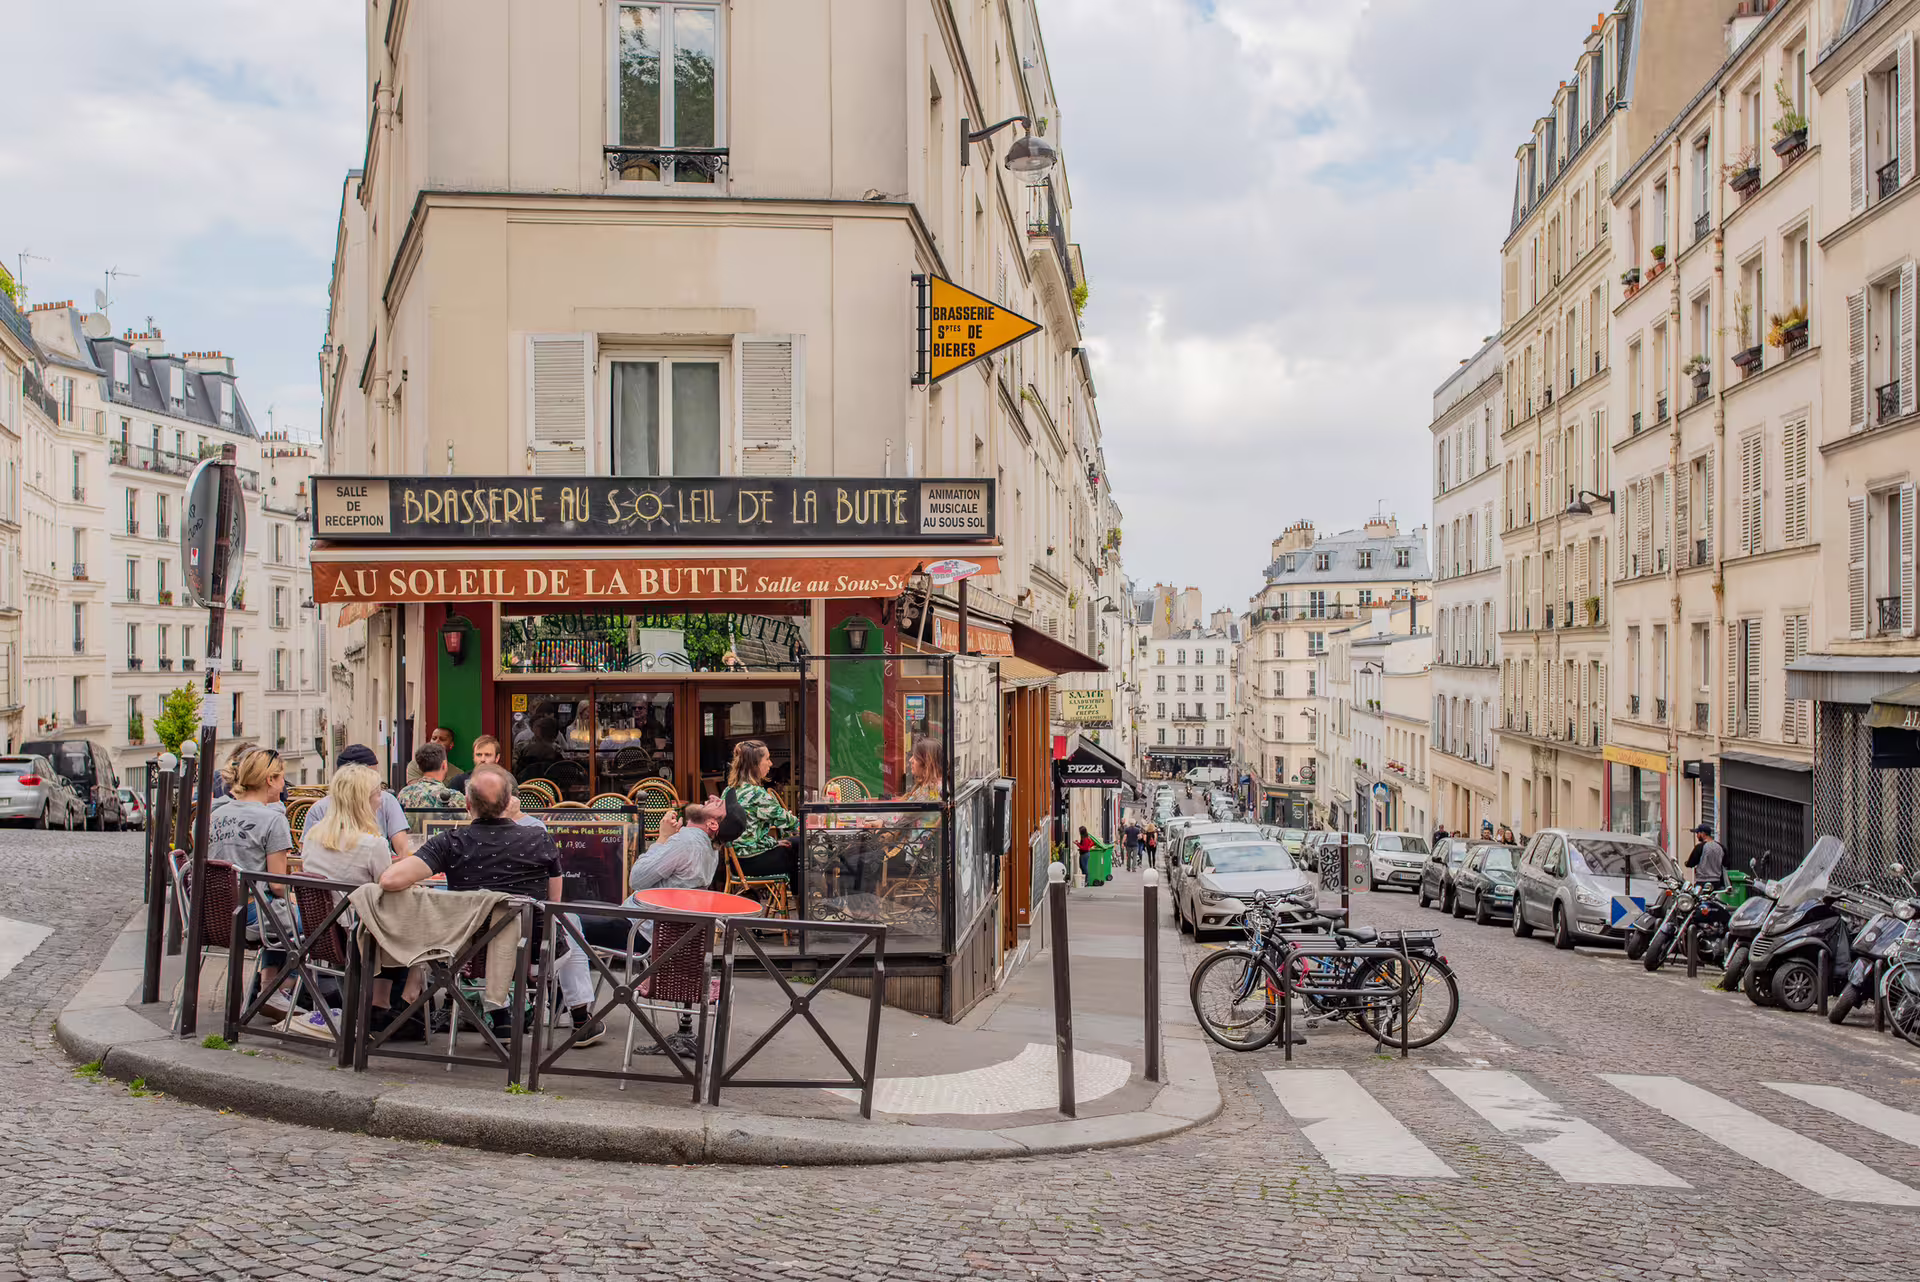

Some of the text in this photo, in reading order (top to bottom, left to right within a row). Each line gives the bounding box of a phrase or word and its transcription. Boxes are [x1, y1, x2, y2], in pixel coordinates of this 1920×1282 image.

[933, 306, 994, 320] BRASSERIE
[967, 324, 983, 339] DE
[933, 342, 976, 357] BIERES
[336, 486, 368, 498] SALLE
[928, 488, 981, 501] ANIMATION
[346, 501, 362, 512] DE
[403, 486, 908, 525] BRASSERIE AU SOLEIL DE LA BUTTE
[929, 503, 978, 515] MUSICALE
[325, 515, 384, 527] RECEPTION
[923, 516, 986, 528] AU SOUS SOL
[330, 569, 379, 598] AU
[389, 568, 516, 597] SOLEIL
[524, 567, 570, 596] DE
[583, 567, 630, 596] LA
[637, 566, 749, 595] BUTTE
[755, 576, 802, 594] Salle
[806, 580, 830, 592] au
[510, 605, 801, 647] AU SOLEIL DE LA BUTTE
[1068, 690, 1104, 699] SNACK
[1067, 764, 1105, 773] PIZZA
